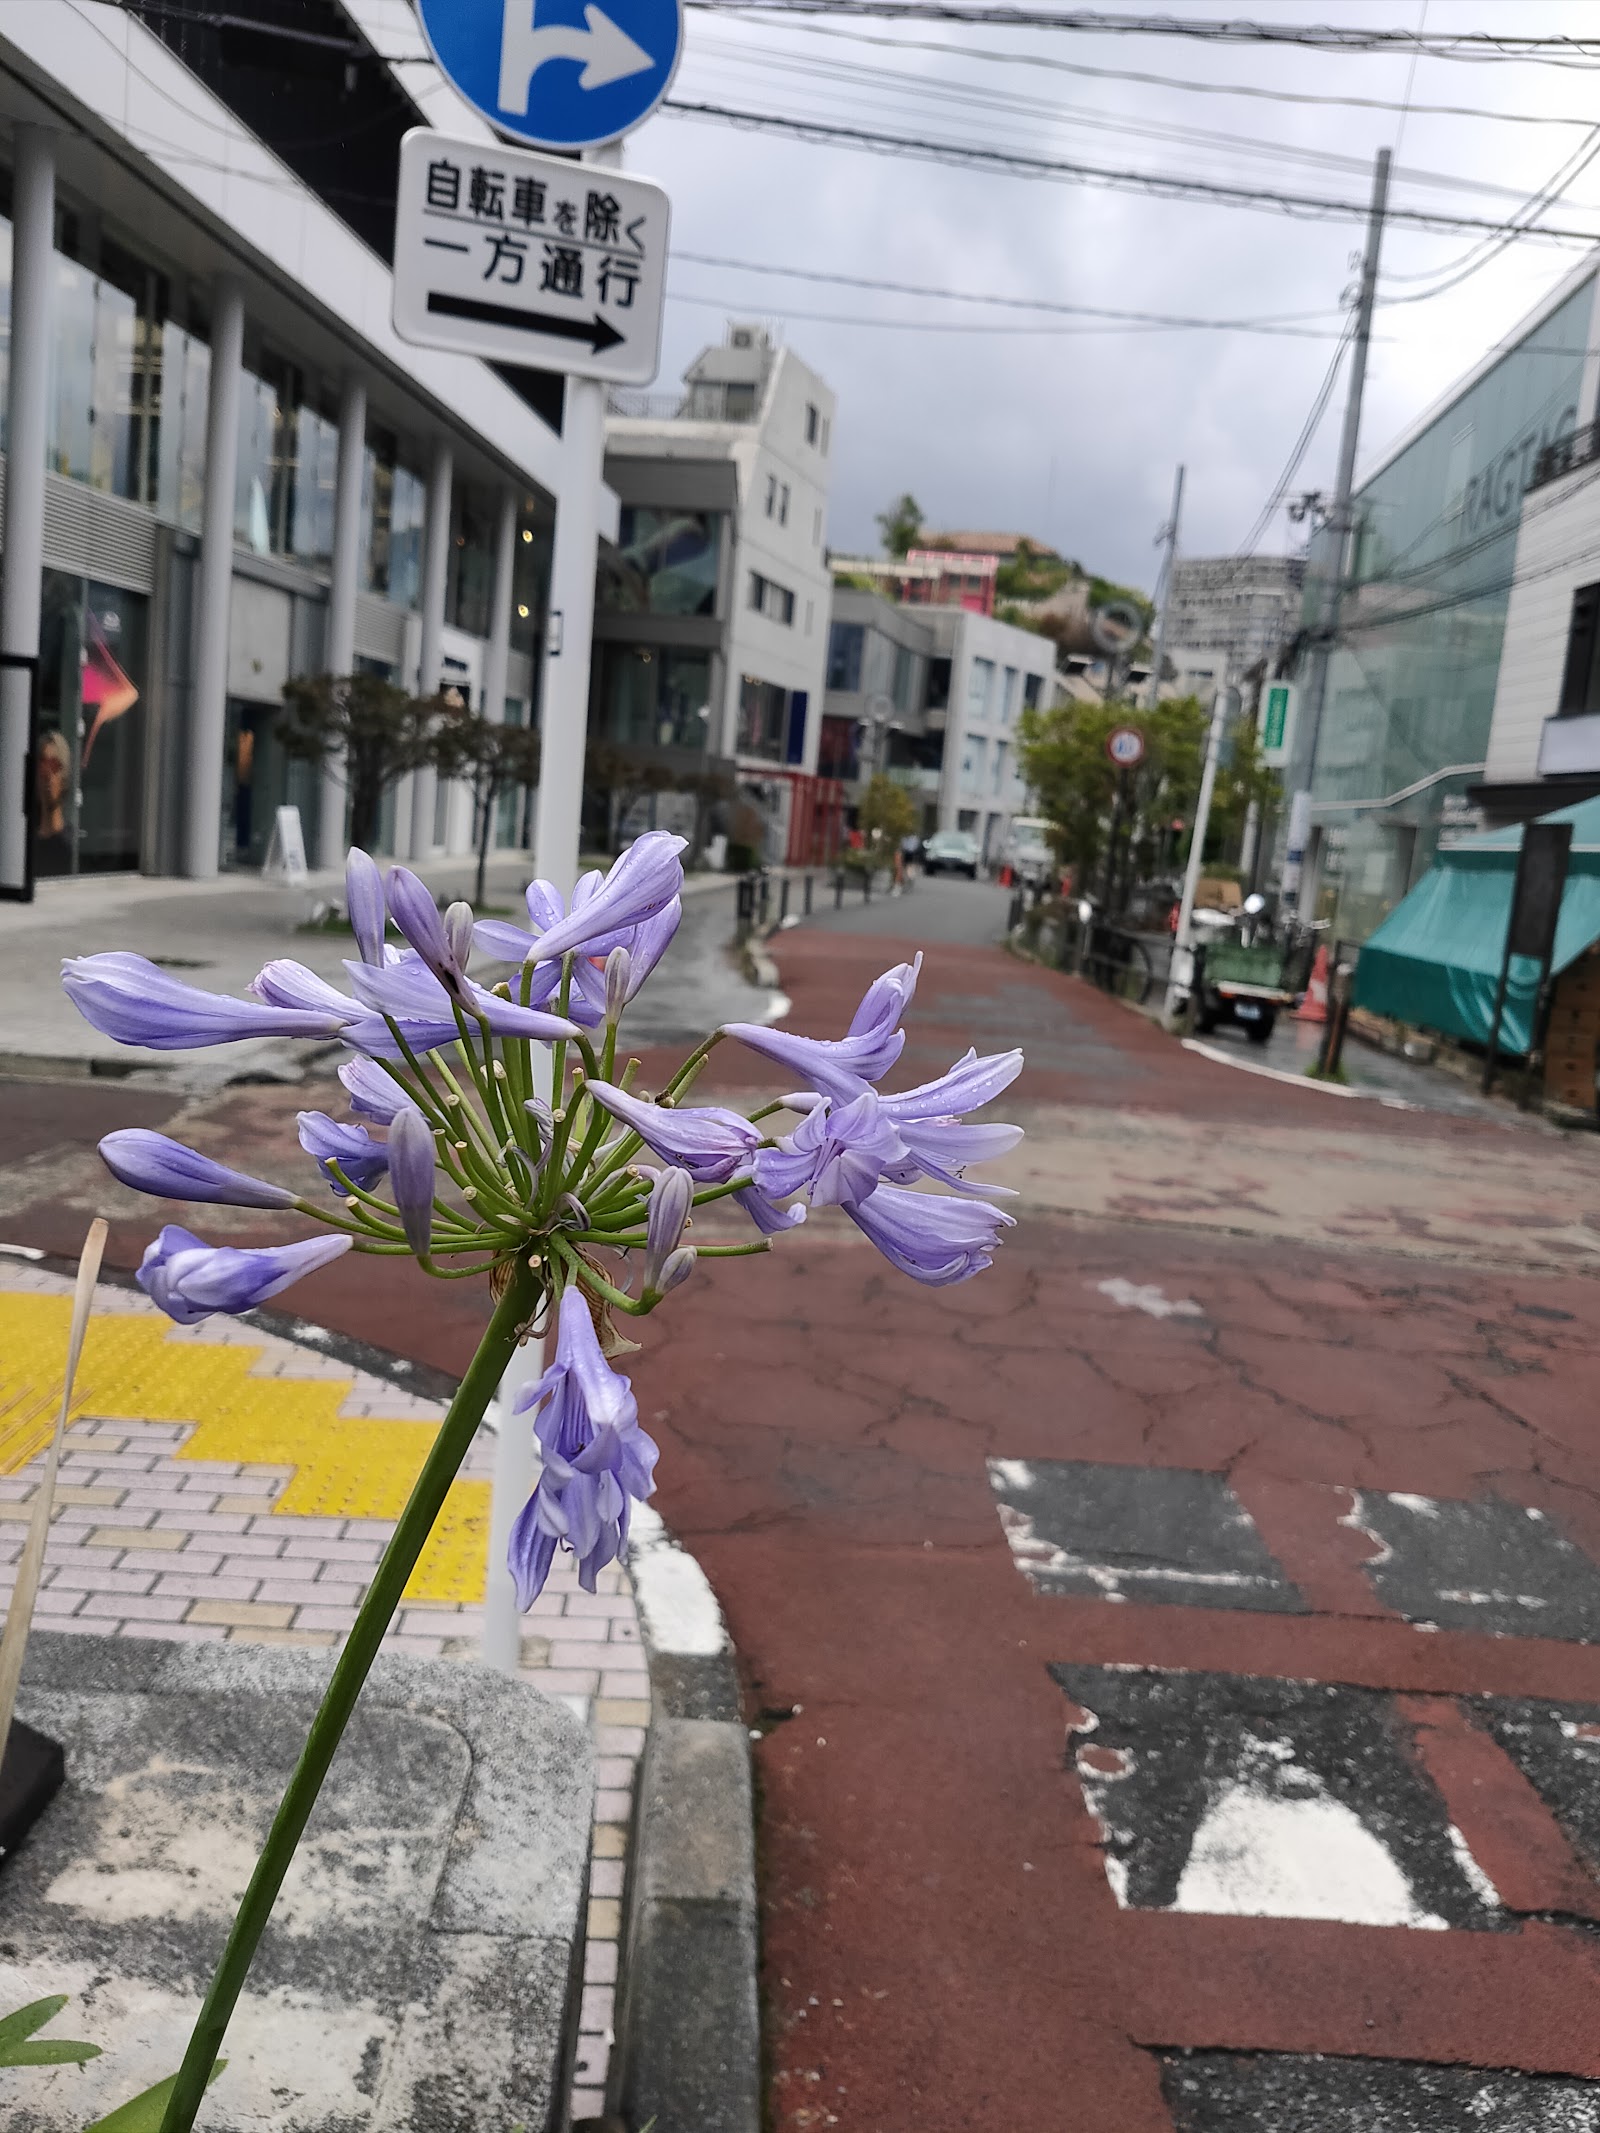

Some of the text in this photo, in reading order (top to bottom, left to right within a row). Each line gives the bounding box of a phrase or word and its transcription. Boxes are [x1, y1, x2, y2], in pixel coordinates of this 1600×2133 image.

[426, 158, 647, 251] 自転車を除く
[423, 234, 642, 308] 一方通行
